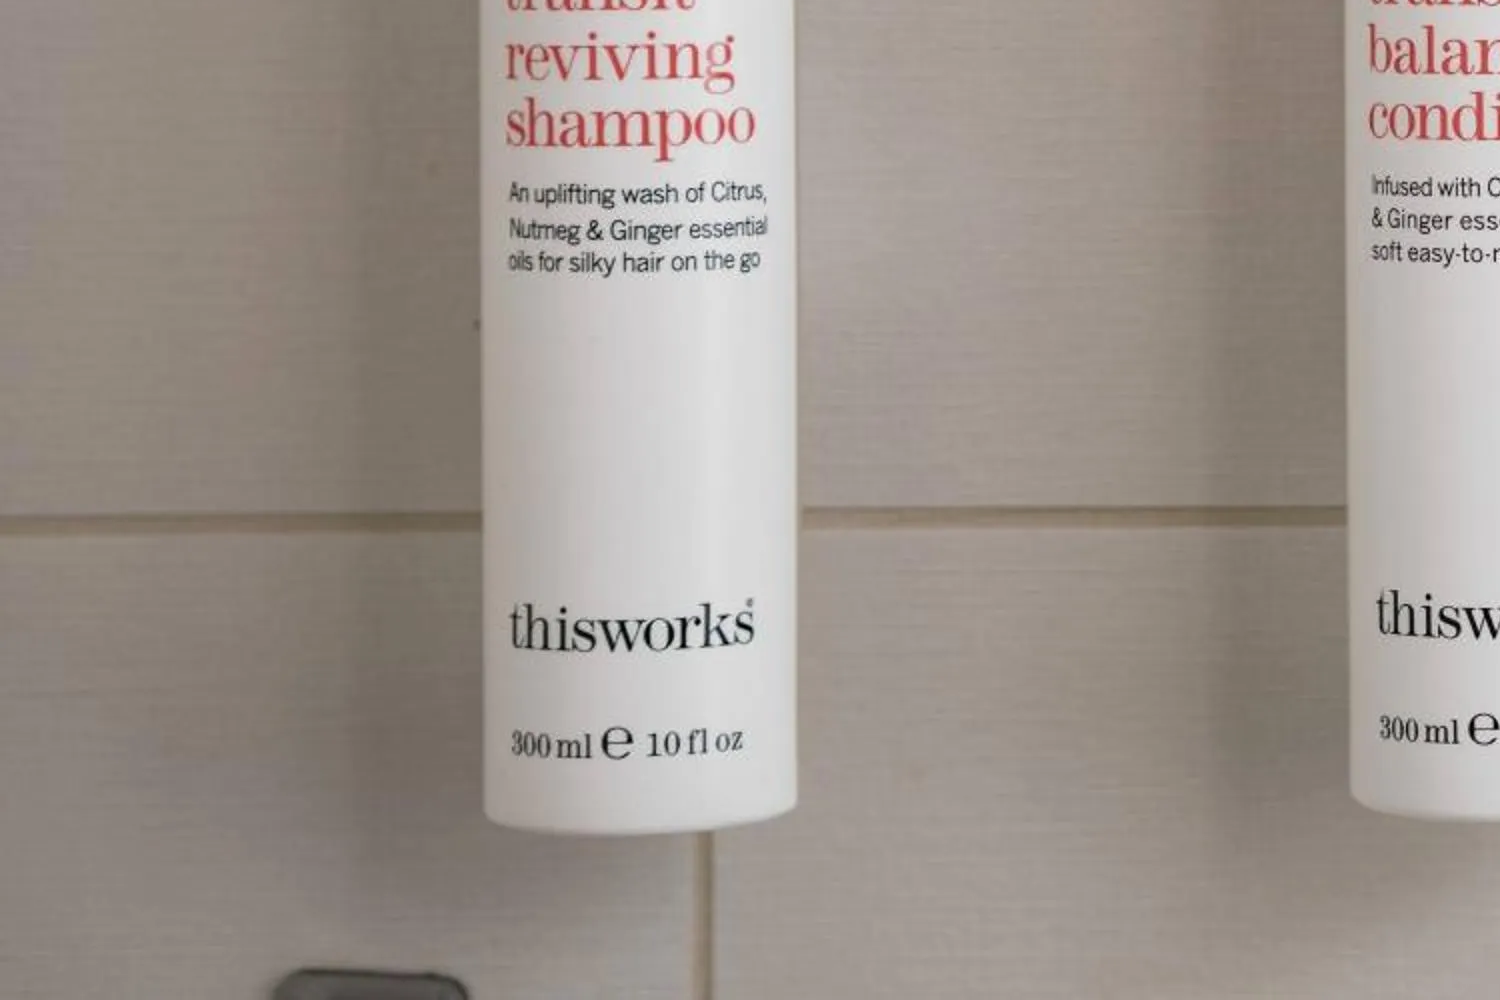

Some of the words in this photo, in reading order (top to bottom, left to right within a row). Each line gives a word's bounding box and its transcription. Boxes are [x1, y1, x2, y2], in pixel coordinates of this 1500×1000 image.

[505, 31, 736, 94] reviving
[505, 97, 756, 163] shampoo
[509, 182, 529, 202] An
[534, 182, 614, 209] uplifting
[622, 182, 679, 204] wash
[685, 181, 708, 203] of
[712, 180, 767, 206] Citrus,
[1371, 174, 1433, 197] Infused
[1438, 175, 1481, 198] with
[509, 217, 580, 244] Nutmeg
[587, 220, 602, 241] &
[610, 219, 682, 244] Ginger
[690, 216, 767, 239] essential
[1371, 207, 1383, 227] &
[1388, 207, 1453, 235] Ginger
[508, 251, 533, 272] oils
[538, 252, 565, 273] for
[569, 252, 614, 278] silky
[623, 253, 664, 274] hair
[670, 253, 697, 272] on
[703, 251, 734, 270] the
[741, 253, 760, 274] go
[1371, 240, 1403, 262] soft
[1379, 714, 1419, 742] 300
[1425, 719, 1458, 745] ml
[511, 729, 550, 758] 300
[556, 732, 592, 760] ml
[648, 730, 681, 758] 10
[688, 728, 708, 755] fl
[716, 730, 744, 753] oz
